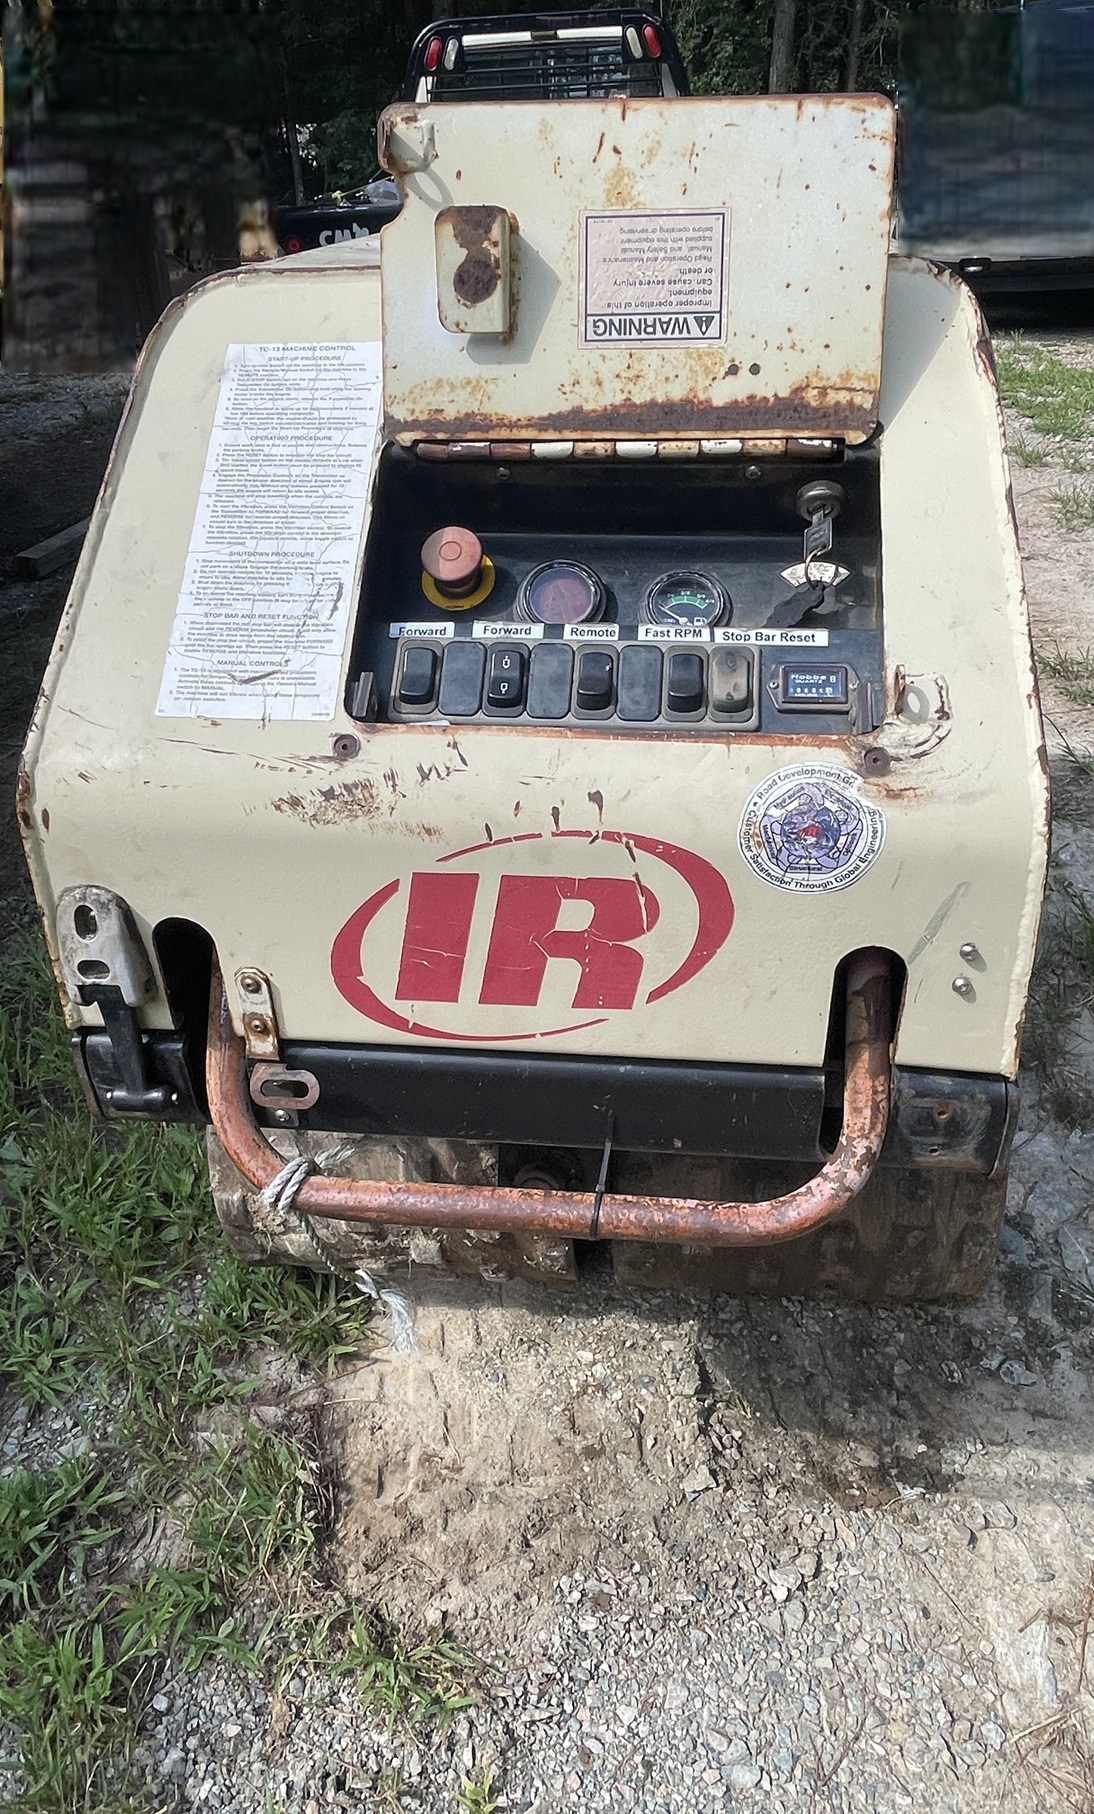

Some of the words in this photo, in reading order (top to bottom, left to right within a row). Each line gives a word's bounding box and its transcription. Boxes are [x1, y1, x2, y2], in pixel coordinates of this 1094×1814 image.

[659, 226, 690, 234] operating
[620, 236, 655, 244] equipment
[685, 236, 713, 244] supplied
[647, 245, 668, 254] Safety
[661, 254, 693, 262] Operation
[613, 278, 636, 287] injury
[634, 300, 673, 308] operation
[676, 299, 712, 307] Improper
[592, 316, 691, 336] WARNING
[398, 626, 447, 636] Forward
[483, 625, 532, 636] Forward
[570, 627, 616, 637] Remote
[645, 628, 671, 638] Fast
[674, 628, 702, 638] RPM
[722, 631, 751, 643] Stop
[755, 632, 776, 642] Bar
[780, 632, 816, 643] Reset
[756, 778, 779, 800] Road
[778, 768, 842, 781] Development
[743, 810, 756, 853] Customer
[750, 853, 792, 886] Satisfaction
[794, 880, 834, 890] Through
[835, 864, 861, 883] Global
[859, 809, 878, 864] Engineering
[395, 872, 660, 1010] IR
